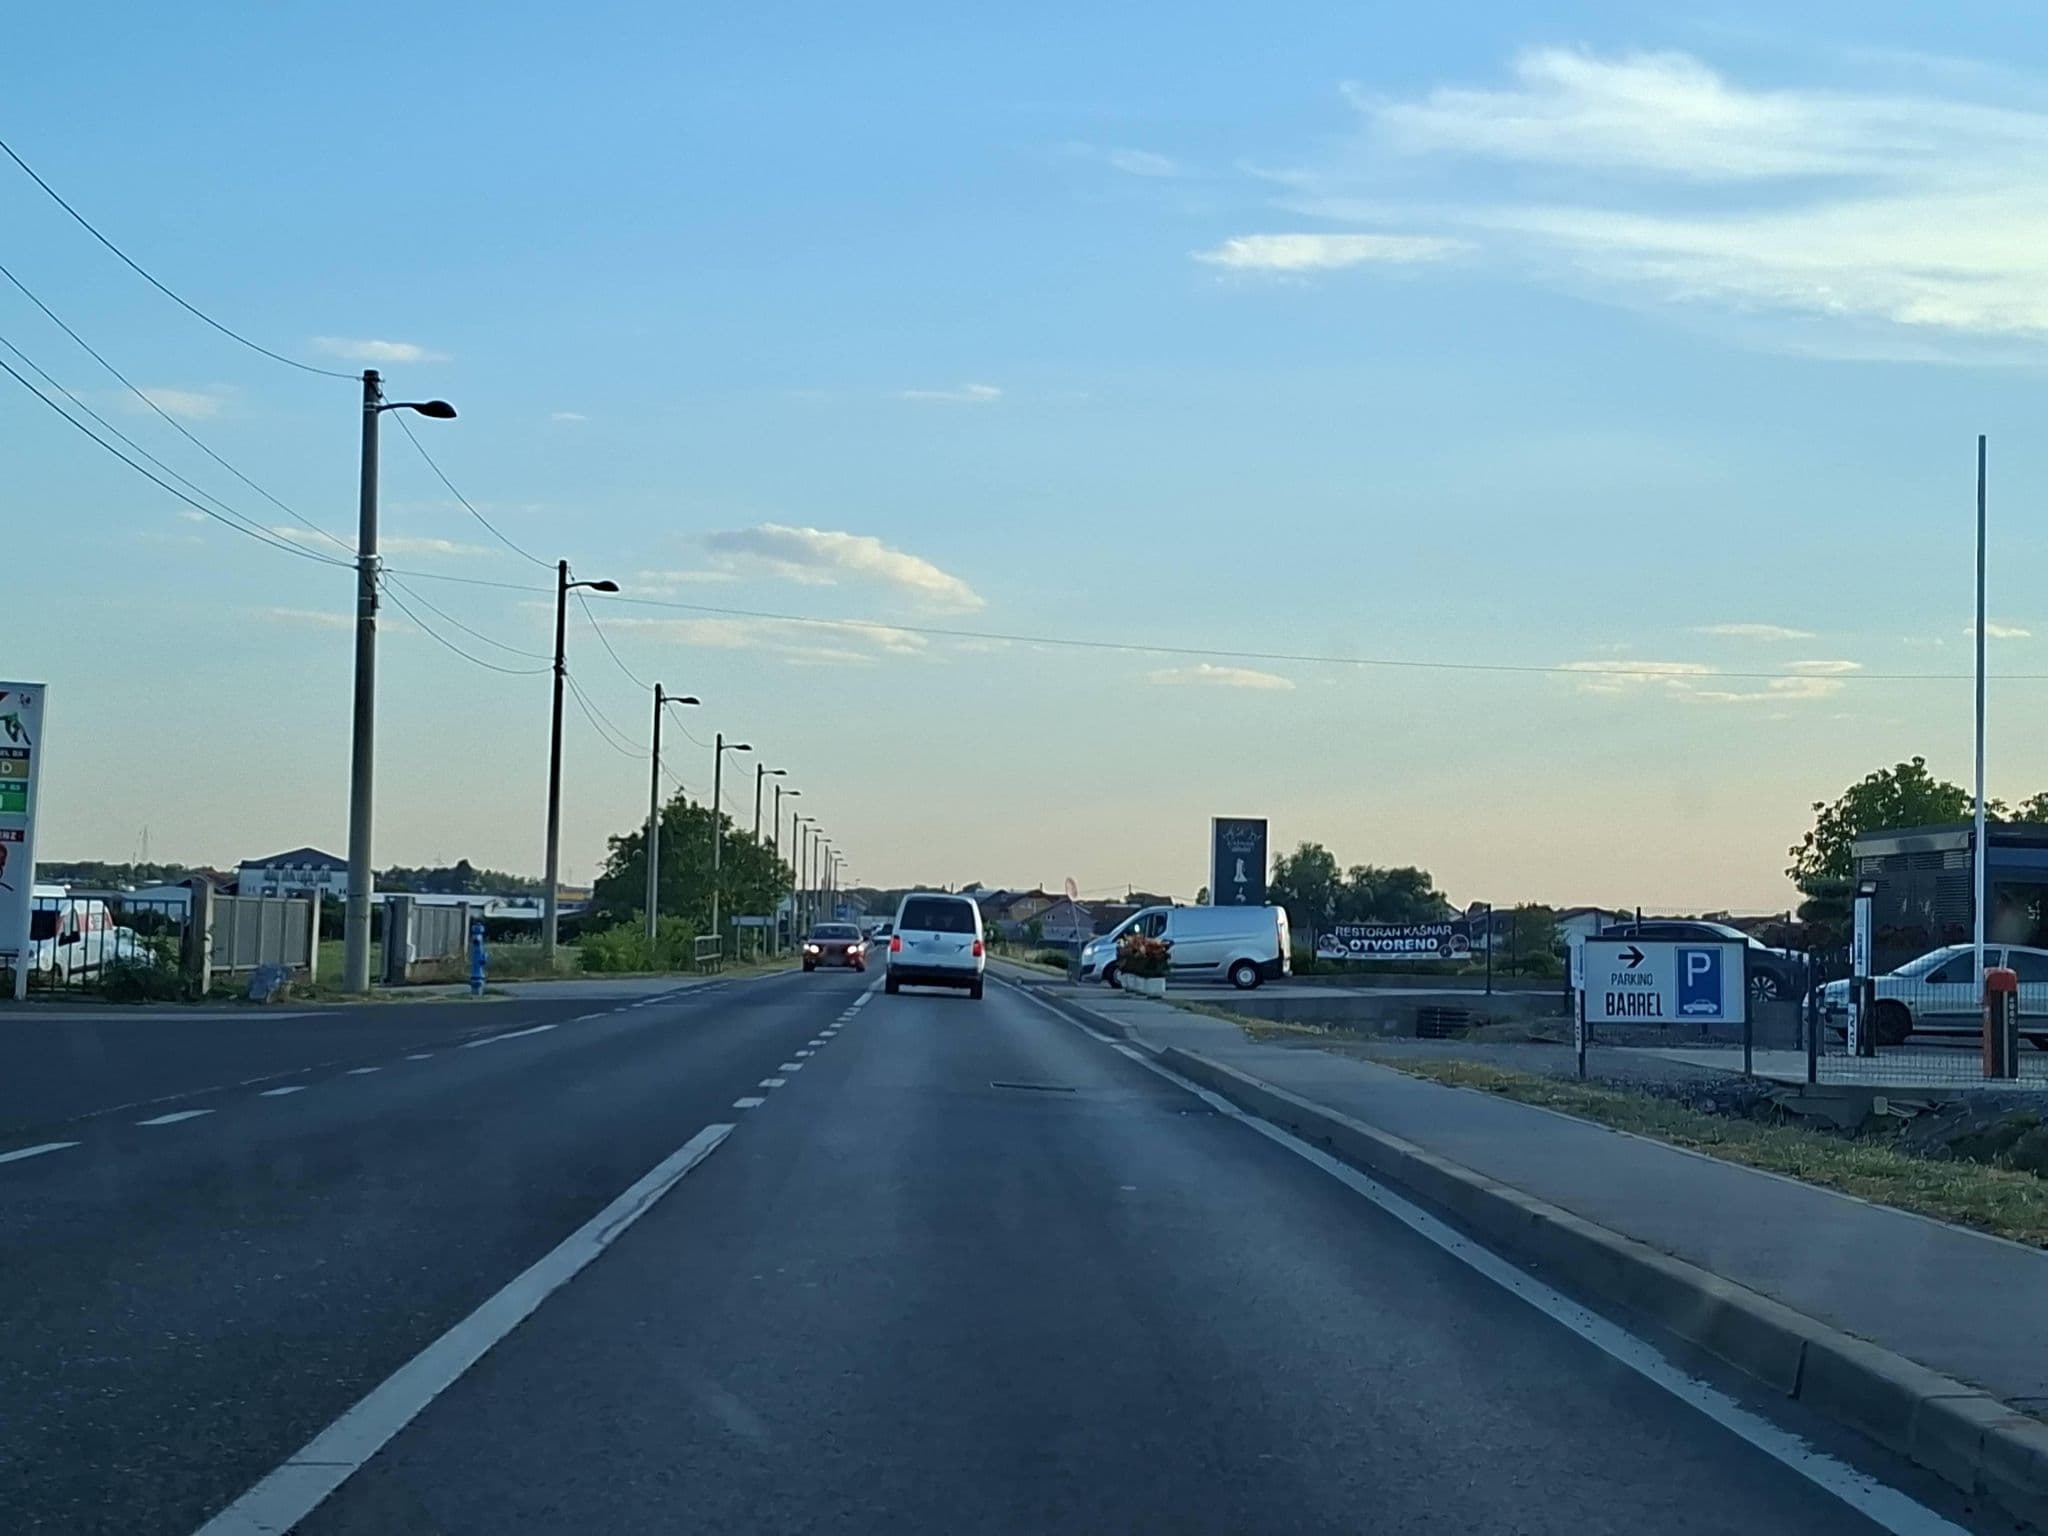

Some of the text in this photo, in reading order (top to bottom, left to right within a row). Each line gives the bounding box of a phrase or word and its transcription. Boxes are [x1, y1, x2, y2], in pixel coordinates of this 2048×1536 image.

[1335, 925, 1400, 937] RESTORAN
[1350, 938, 1438, 950] OTVORENO
[1687, 952, 1711, 987] P
[1606, 992, 1663, 1016] BARREL
